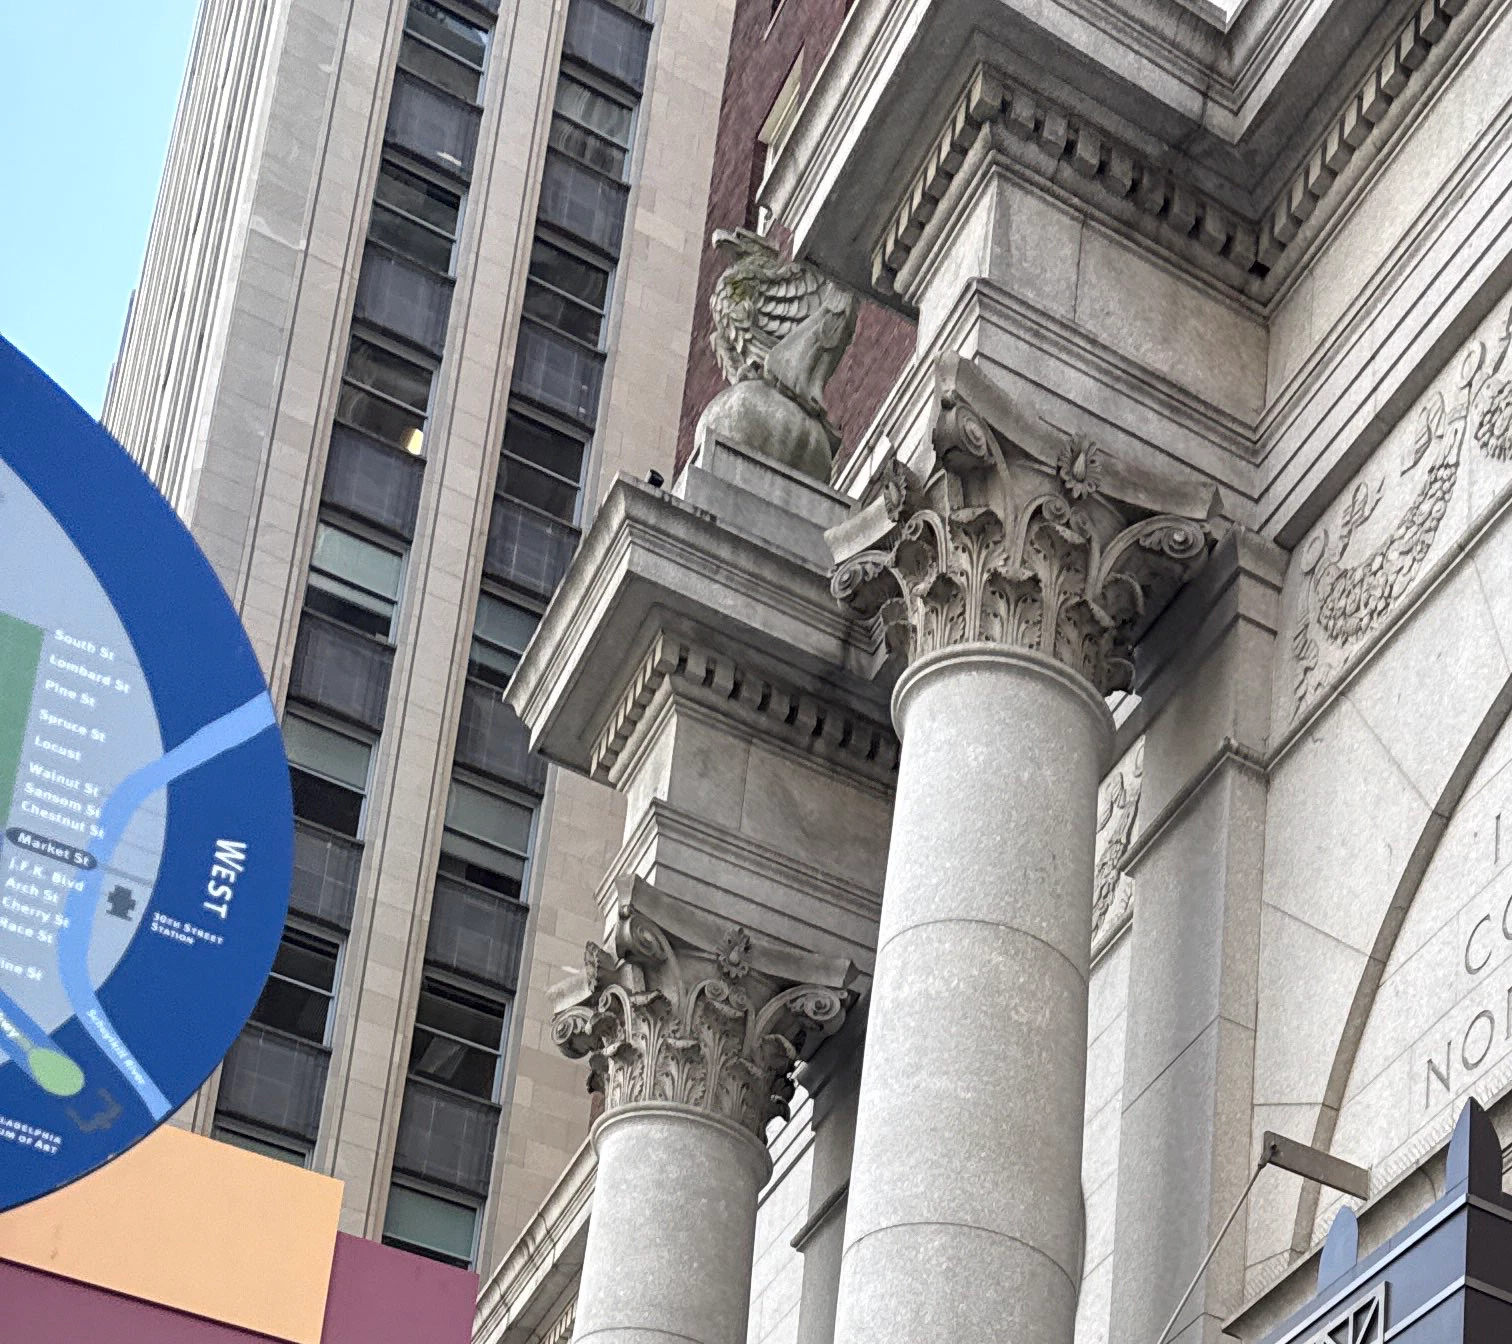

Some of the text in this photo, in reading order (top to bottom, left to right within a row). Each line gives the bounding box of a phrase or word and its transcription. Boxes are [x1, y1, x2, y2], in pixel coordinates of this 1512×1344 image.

[54, 629, 115, 661] South St
[49, 654, 131, 694] Lombard St
[44, 679, 96, 707] Pine St
[39, 708, 106, 743] Spruce St
[34, 735, 82, 760] Locust
[29, 761, 99, 798] Walnut St
[23, 782, 101, 819] Sansom St
[21, 800, 105, 840] Chestnut St
[18, 832, 90, 867] Market St
[5, 877, 60, 904] Arch St
[203, 839, 248, 919] WEST
[2, 896, 51, 923] Cherry
[37, 929, 53, 945] St
